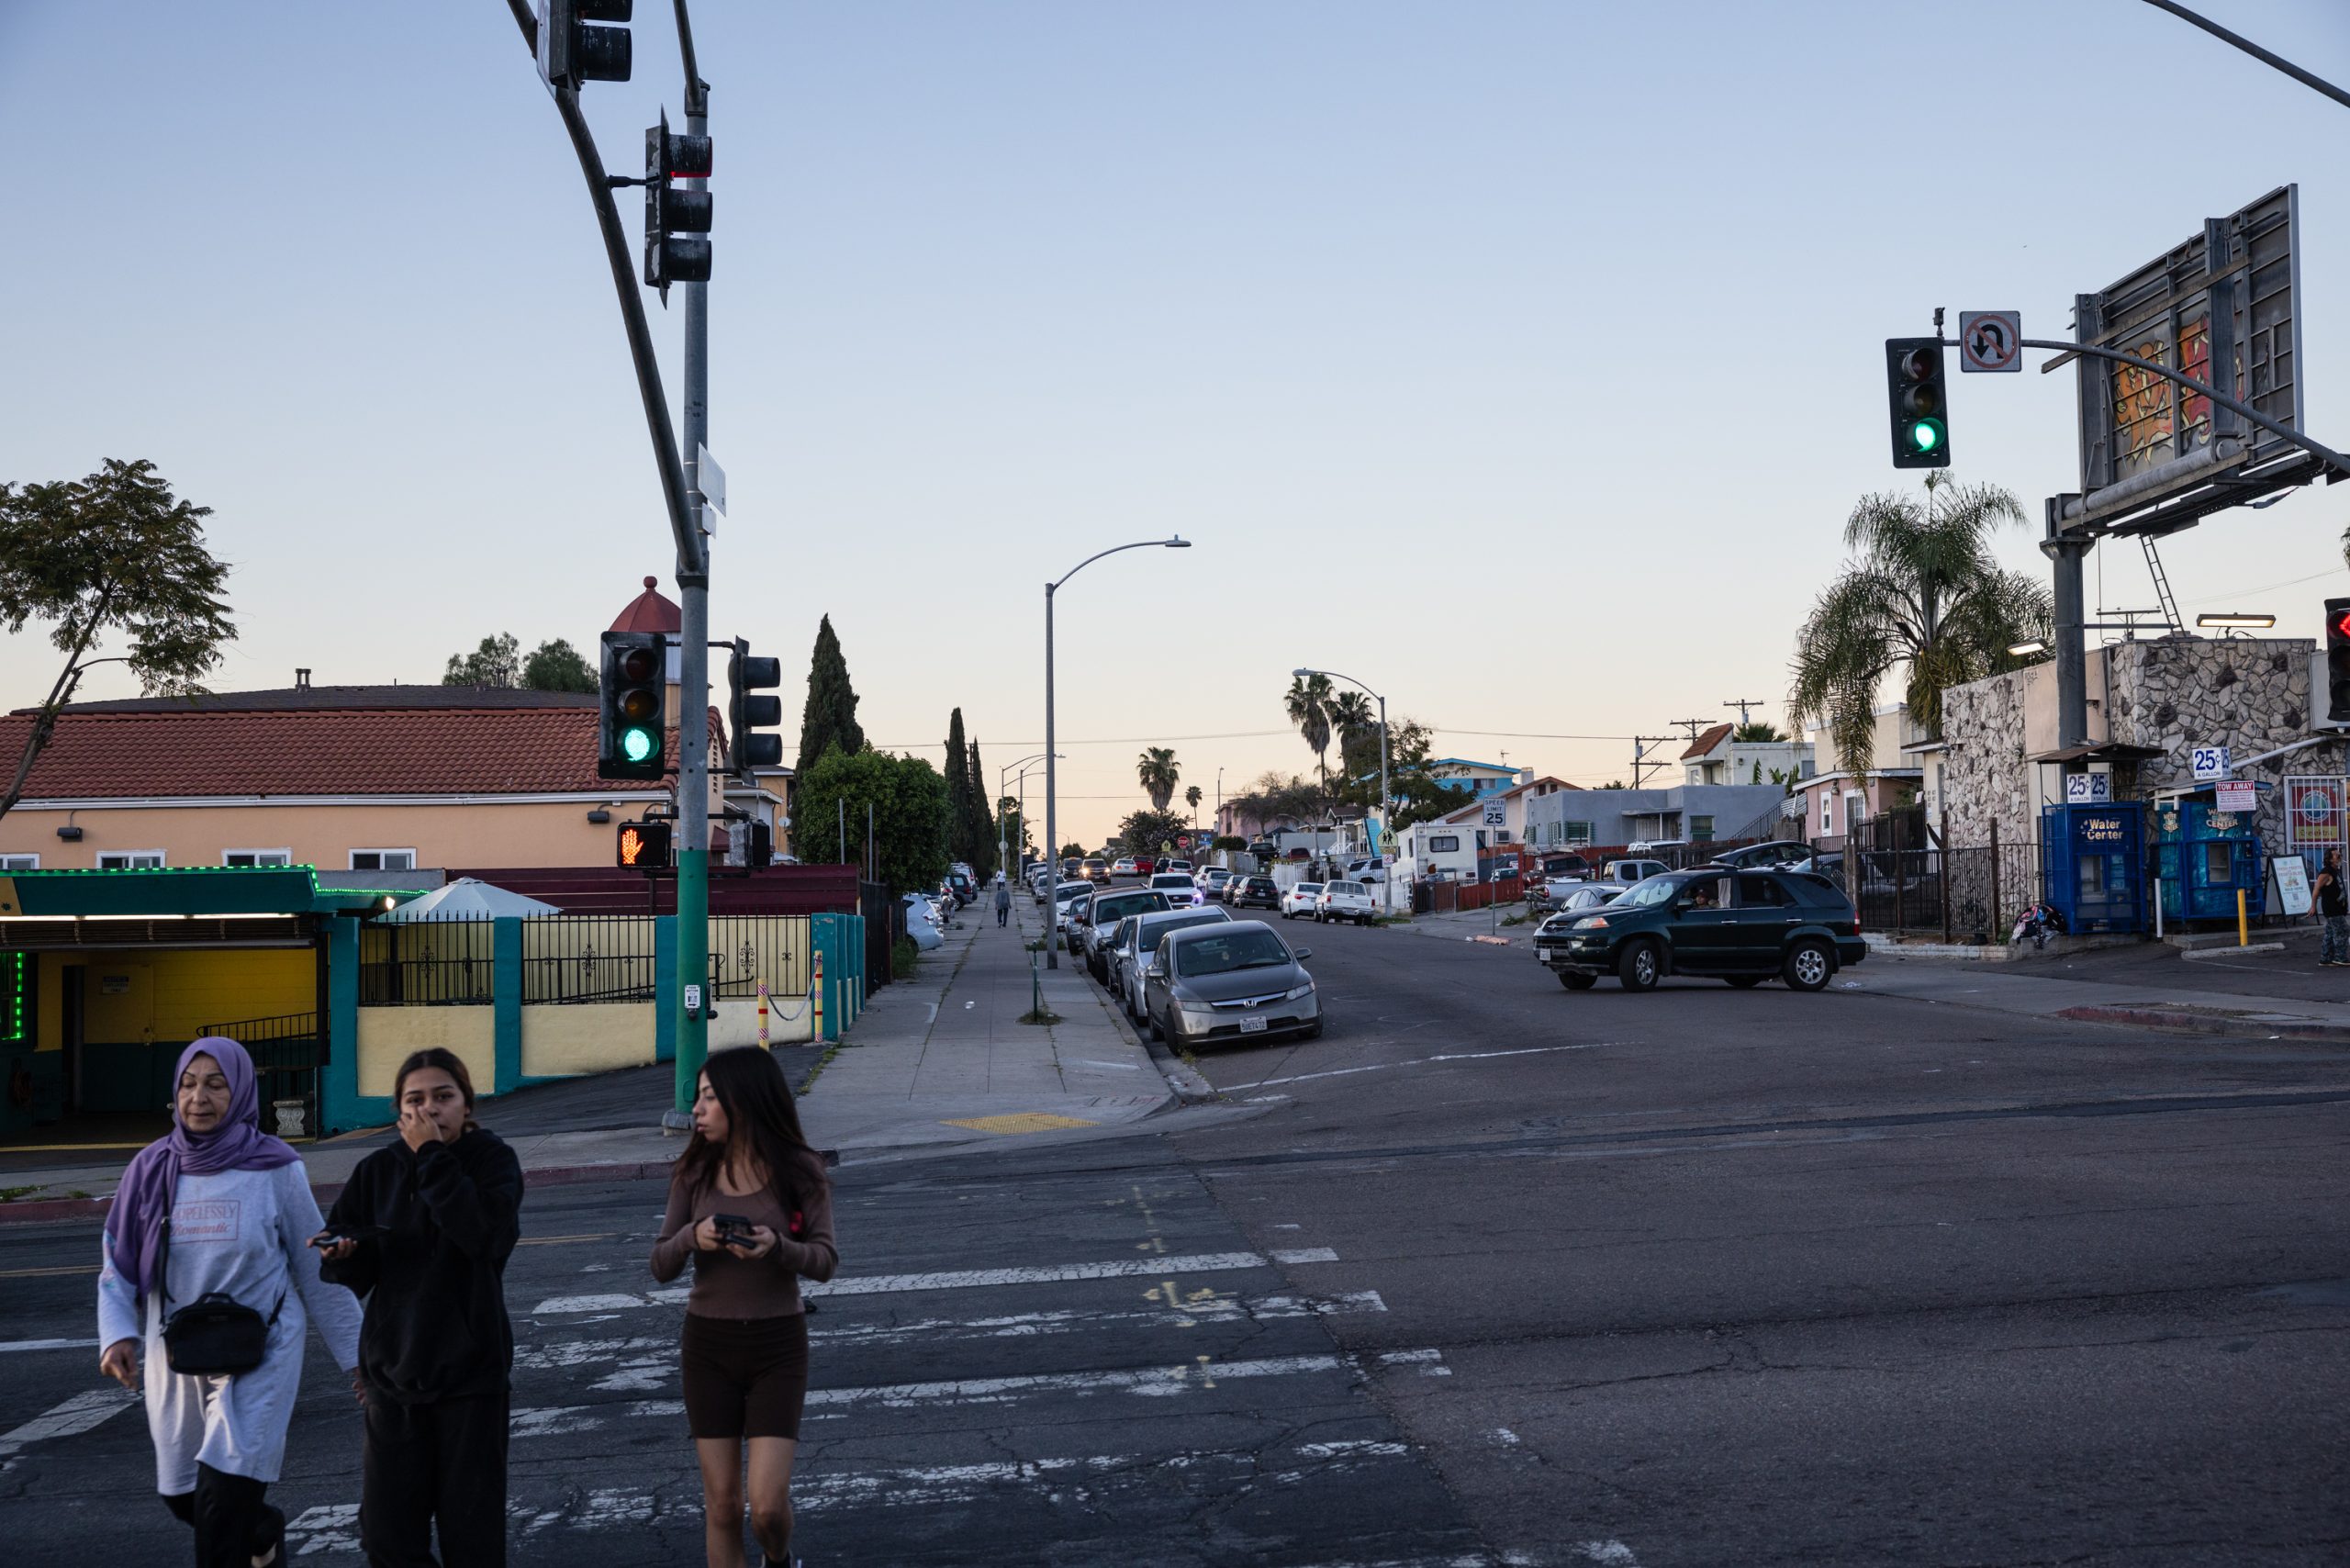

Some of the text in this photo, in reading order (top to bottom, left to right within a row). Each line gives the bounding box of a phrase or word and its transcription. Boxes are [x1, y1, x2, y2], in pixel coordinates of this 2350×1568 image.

[1486, 812, 1504, 824] 25
[2088, 818, 2121, 829] Water
[2206, 819, 2238, 829] CENTER
[2087, 829, 2123, 840] Center
